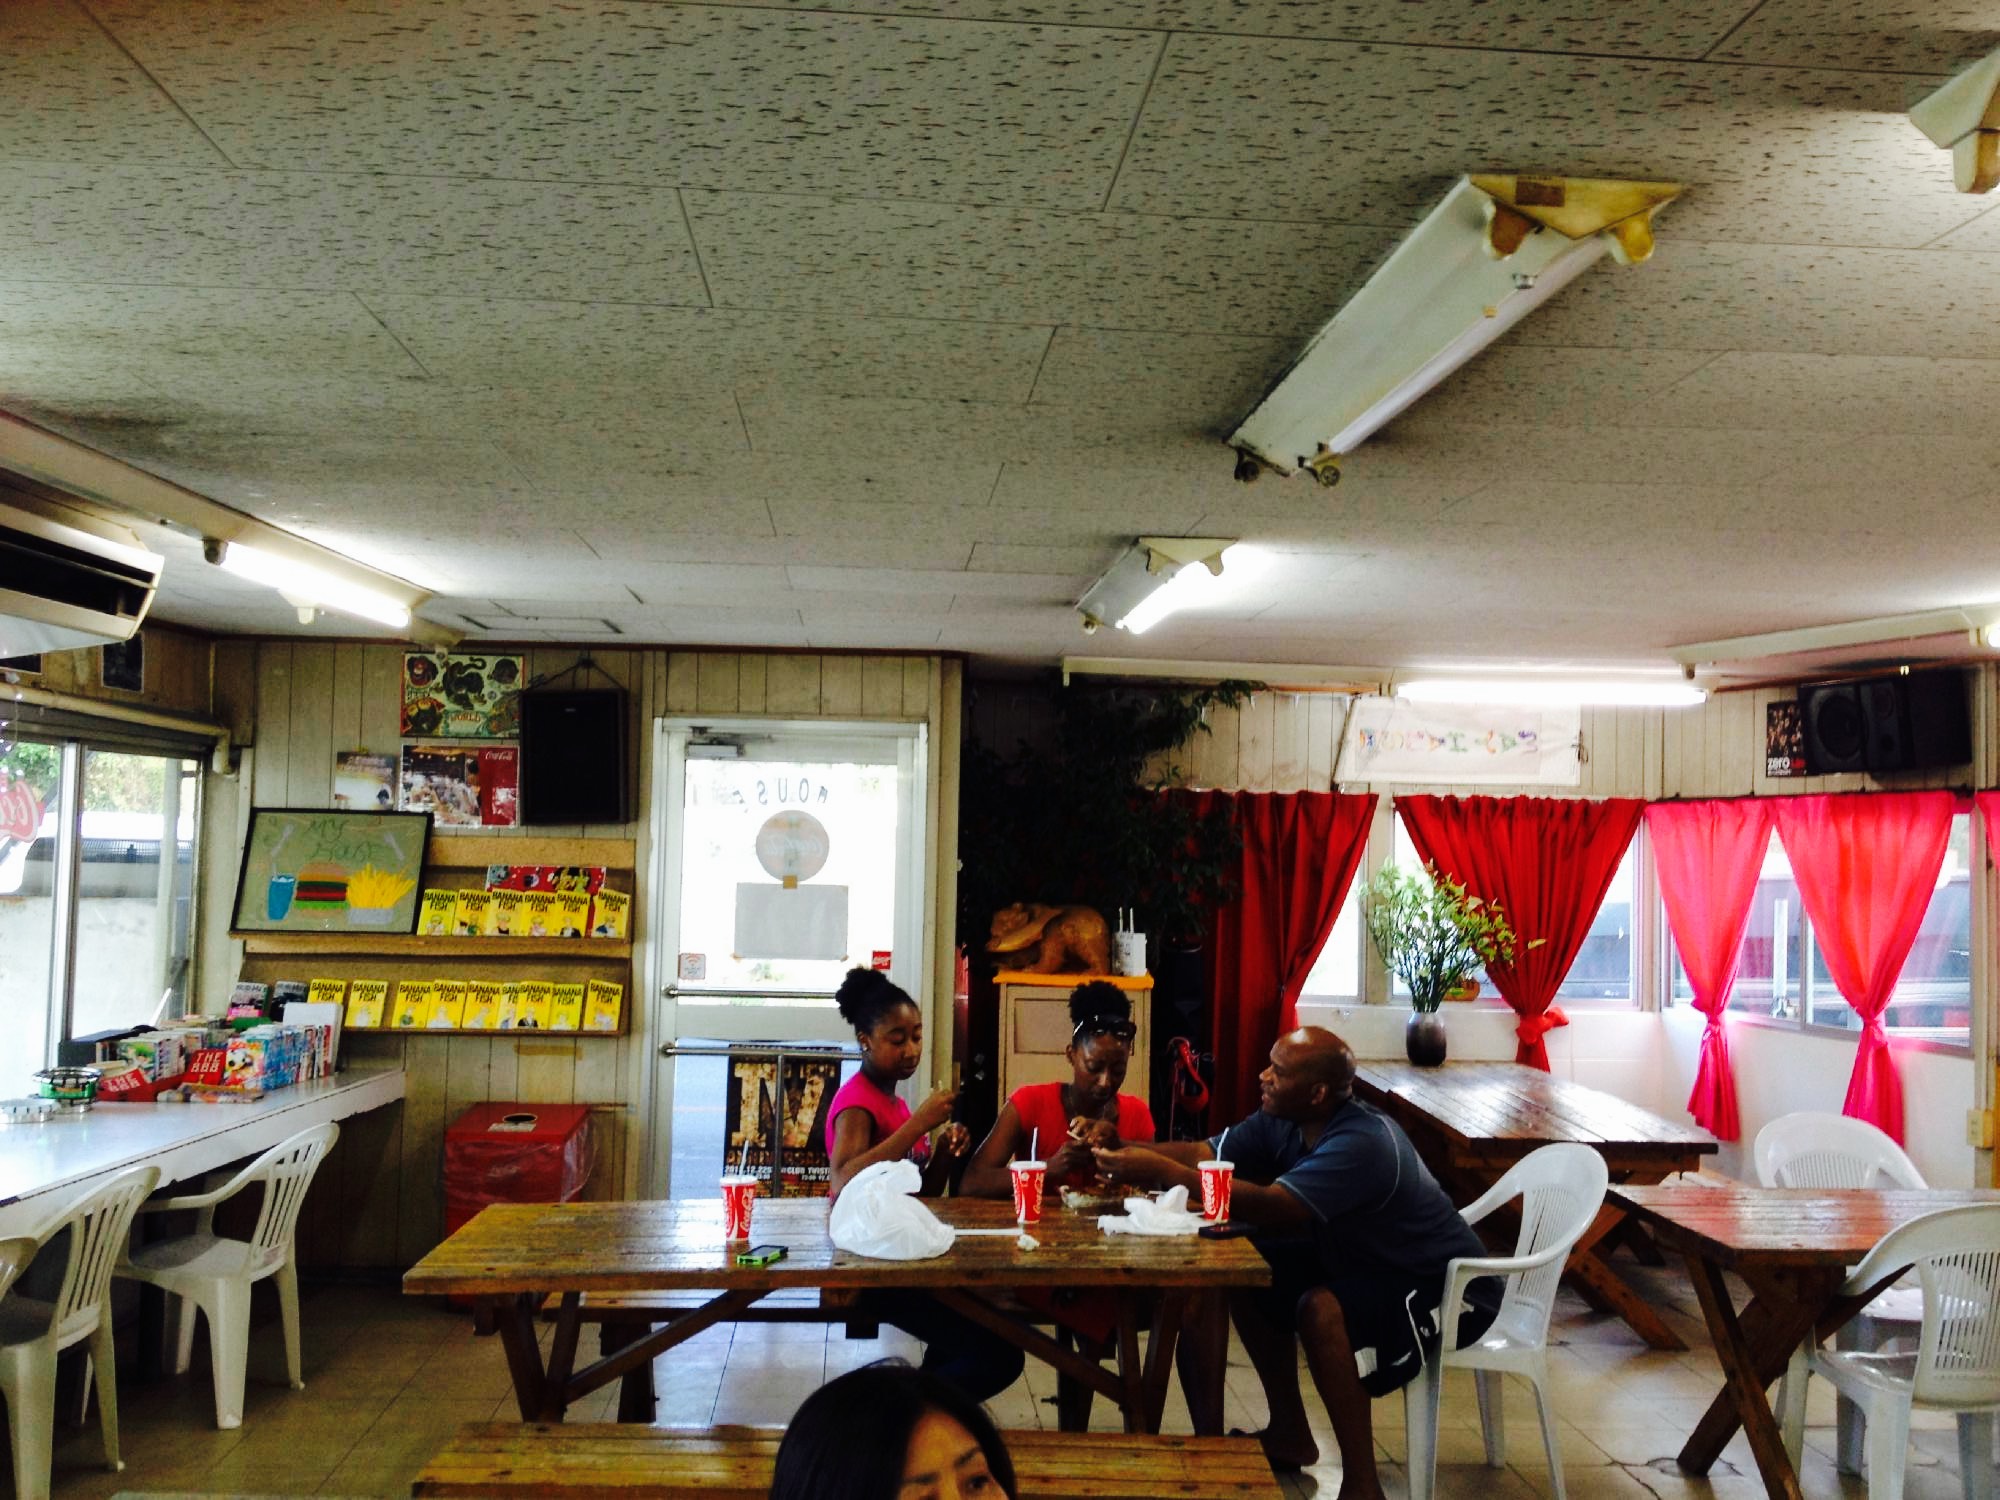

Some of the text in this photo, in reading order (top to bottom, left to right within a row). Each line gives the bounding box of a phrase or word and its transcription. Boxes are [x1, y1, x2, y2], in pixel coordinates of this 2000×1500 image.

[424, 891, 456, 903] BANANA
[460, 892, 491, 904] BANANA
[492, 891, 523, 903] BANANA
[525, 894, 556, 904] BANANA
[556, 893, 588, 905] BANANA
[598, 890, 628, 905] BANANA
[430, 900, 448, 912] FISH
[465, 901, 483, 912] FISH
[498, 900, 516, 911] FISH
[530, 901, 548, 912] FISH
[563, 902, 581, 913] FISH
[604, 901, 621, 912] FISH
[311, 981, 344, 993] BANANA
[353, 982, 385, 994] BANANA
[400, 984, 431, 994] BANANA
[433, 983, 465, 993] BANANA
[468, 984, 500, 995] BANANA
[520, 984, 550, 995] BANANA
[552, 986, 582, 996] BANANA
[590, 983, 620, 996] BANANA
[317, 991, 336, 1001] FISH
[358, 991, 377, 1001] FISH
[405, 992, 423, 1003] FISH
[439, 992, 457, 1002] FISH
[475, 993, 493, 1004] FISH
[526, 993, 543, 1003] FISH
[557, 995, 575, 1005] FISH
[596, 993, 613, 1004] FISH
[195, 1051, 223, 1062] THE
